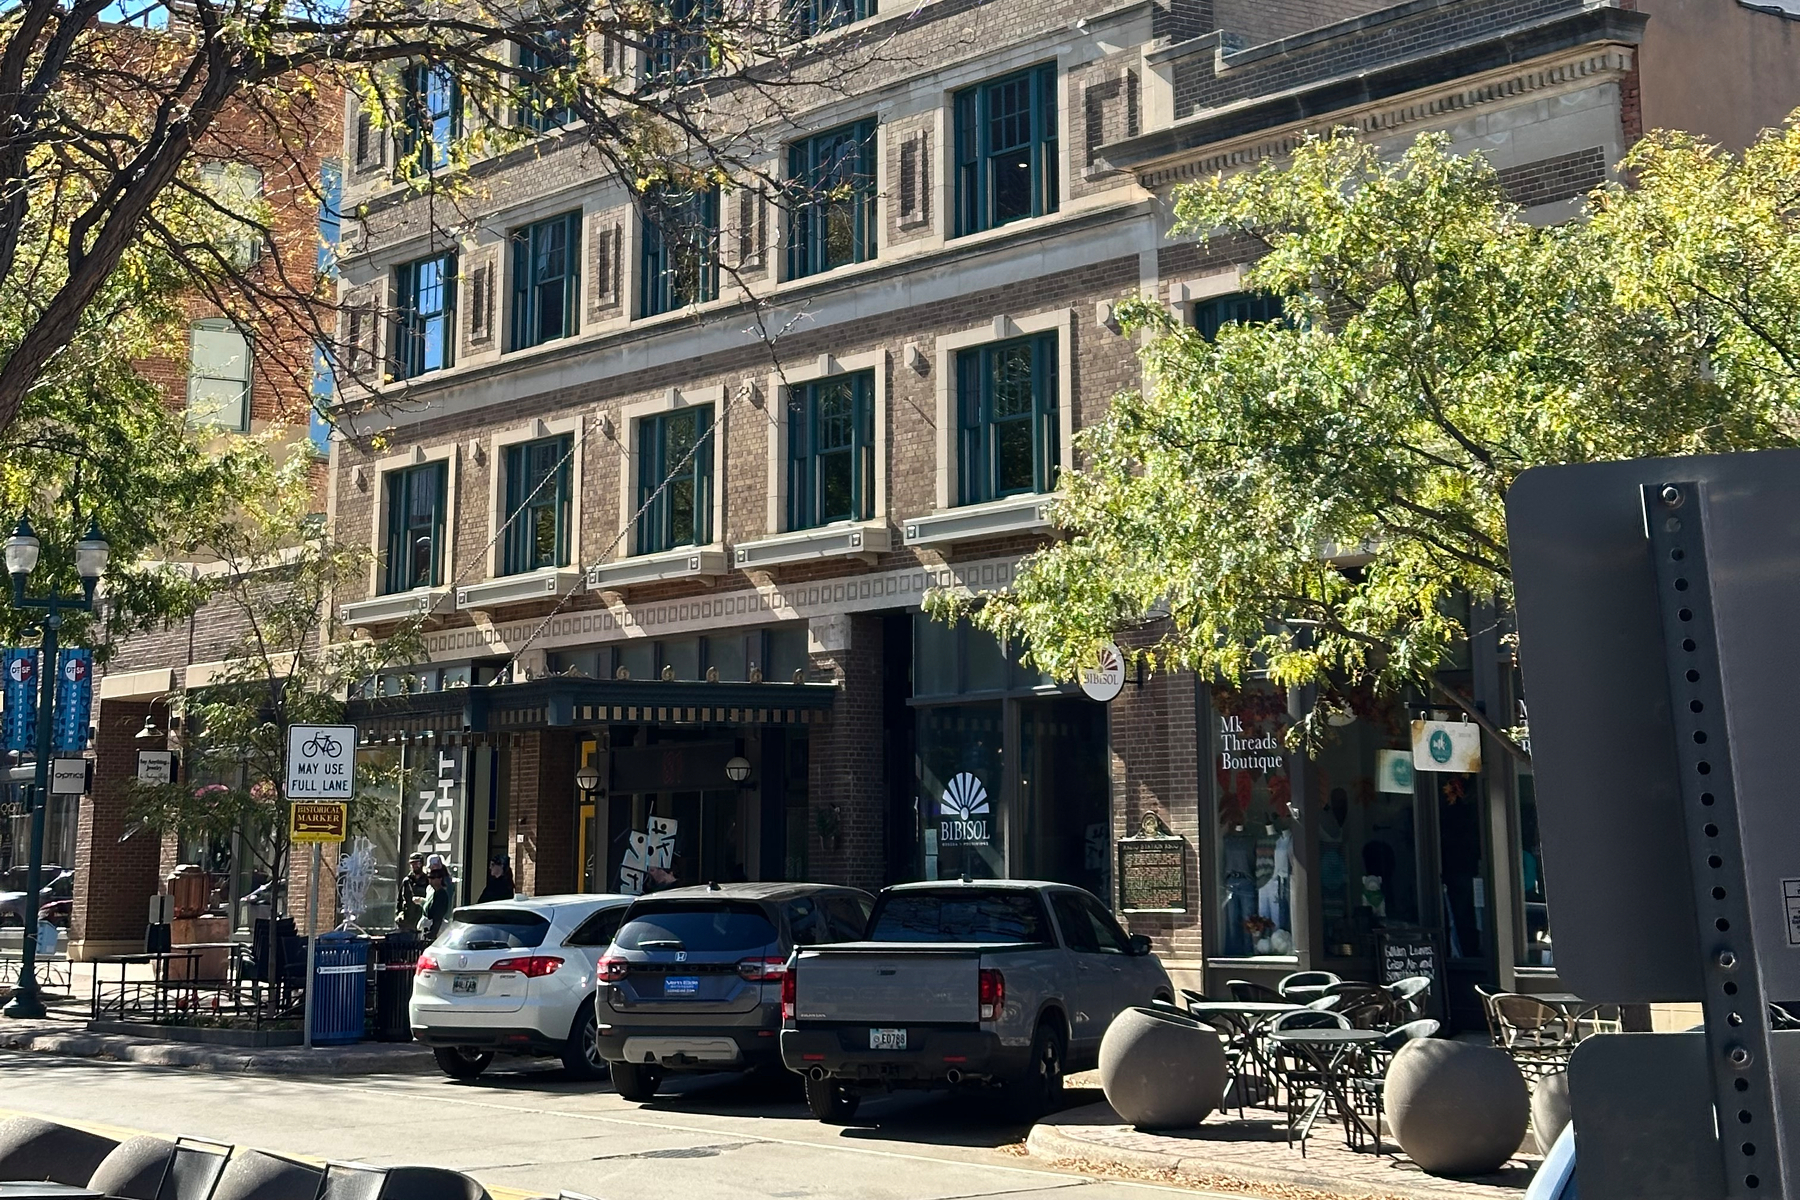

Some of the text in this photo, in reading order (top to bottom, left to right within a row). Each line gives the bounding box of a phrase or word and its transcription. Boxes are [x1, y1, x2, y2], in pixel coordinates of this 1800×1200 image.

[67, 684, 78, 743] DOWNTOWN
[1220, 715, 1244, 733] Mk
[1220, 732, 1278, 751] Threads
[298, 763, 344, 775] MAY USE
[1221, 751, 1283, 774] Boutique
[291, 780, 348, 791] FULL LANE
[297, 805, 340, 814] HISTORICAL
[297, 814, 340, 822] MARKER
[940, 820, 991, 841] BIBISOL
